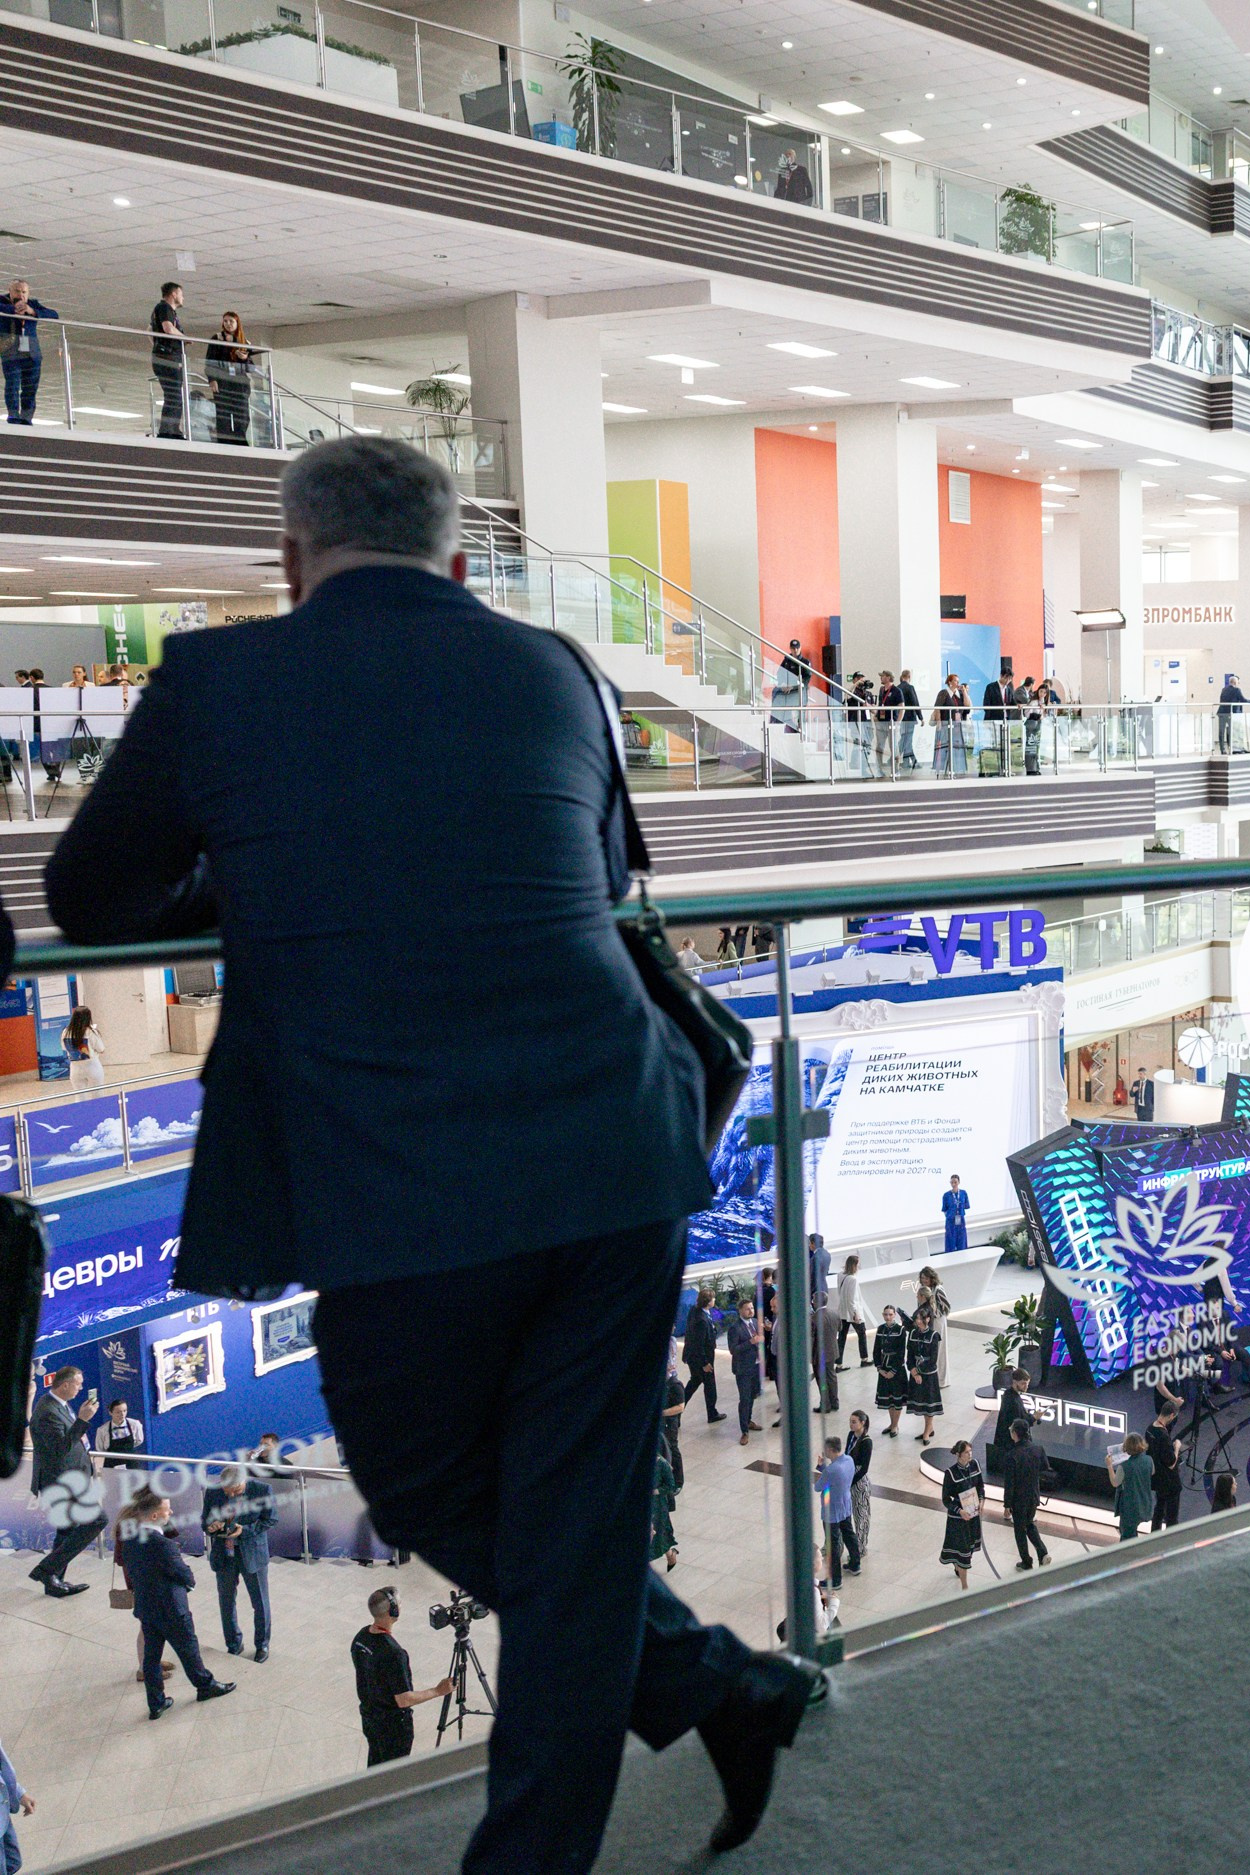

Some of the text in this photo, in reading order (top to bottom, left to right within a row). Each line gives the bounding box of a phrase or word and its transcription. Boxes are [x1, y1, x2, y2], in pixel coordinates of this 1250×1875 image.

[1143, 606, 1234, 624] ЗПРОМБАНК
[919, 909, 1048, 975] VTB
[868, 1052, 907, 1062] ЦЕНТР
[865, 1060, 963, 1073] РЕАБИЛИТАЦИИ
[861, 1070, 979, 1085] ДИКИХ ЖИВОТНЫХ
[859, 1083, 945, 1096] НА КАМЧАТКЕ
[1132, 1298, 1223, 1338] EASTERN
[1133, 1320, 1239, 1364] ECONOMIC
[1133, 1356, 1206, 1391] FORUM
